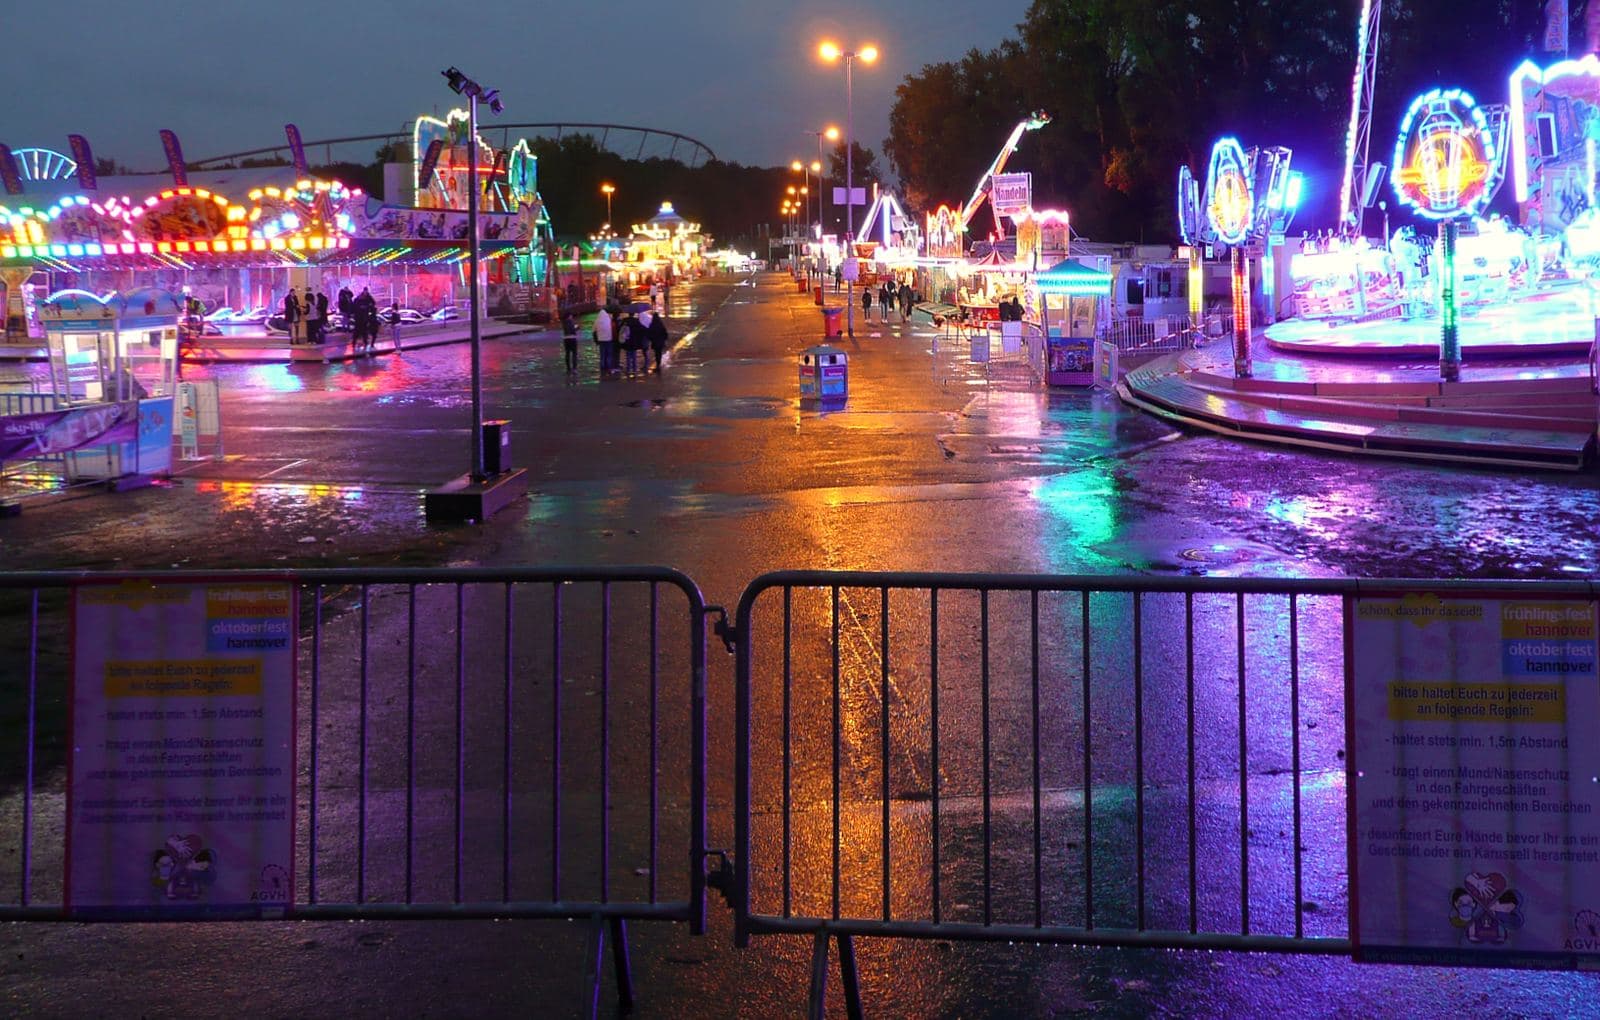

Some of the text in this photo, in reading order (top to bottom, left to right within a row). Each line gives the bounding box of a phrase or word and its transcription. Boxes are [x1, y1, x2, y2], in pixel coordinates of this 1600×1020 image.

[211, 620, 289, 634] oktoberfest
[1525, 622, 1591, 636] hannover
[226, 637, 287, 649] hannover
[1508, 642, 1593, 656] oktoberfest
[1525, 658, 1592, 672] hannover
[1393, 687, 1558, 702] bitte haltet Euch zu jederzeit
[219, 707, 264, 720] Abstand
[1417, 704, 1534, 718] an folgende Regeln:
[1392, 735, 1424, 746] haltet
[1427, 735, 1457, 746] stets
[1459, 736, 1485, 747] min.
[1488, 736, 1516, 749] 1,5m
[1519, 736, 1568, 749] Abstand
[1423, 767, 1454, 778] einen
[1457, 767, 1569, 780] Mund/Nasenschutz
[1416, 782, 1546, 797] in den Fahrgeschäften
[1372, 796, 1592, 813] und den gekennzeichneten Bereichen
[1435, 830, 1462, 842] Eure
[1465, 829, 1503, 843] Hände
[1506, 831, 1539, 844] bevor
[1543, 831, 1558, 844] Ihr
[1581, 833, 1598, 845] ein
[1423, 846, 1449, 858] oder
[1453, 847, 1471, 858] ein
[1474, 846, 1530, 860] Karussell
[250, 890, 287, 901] AGVH
